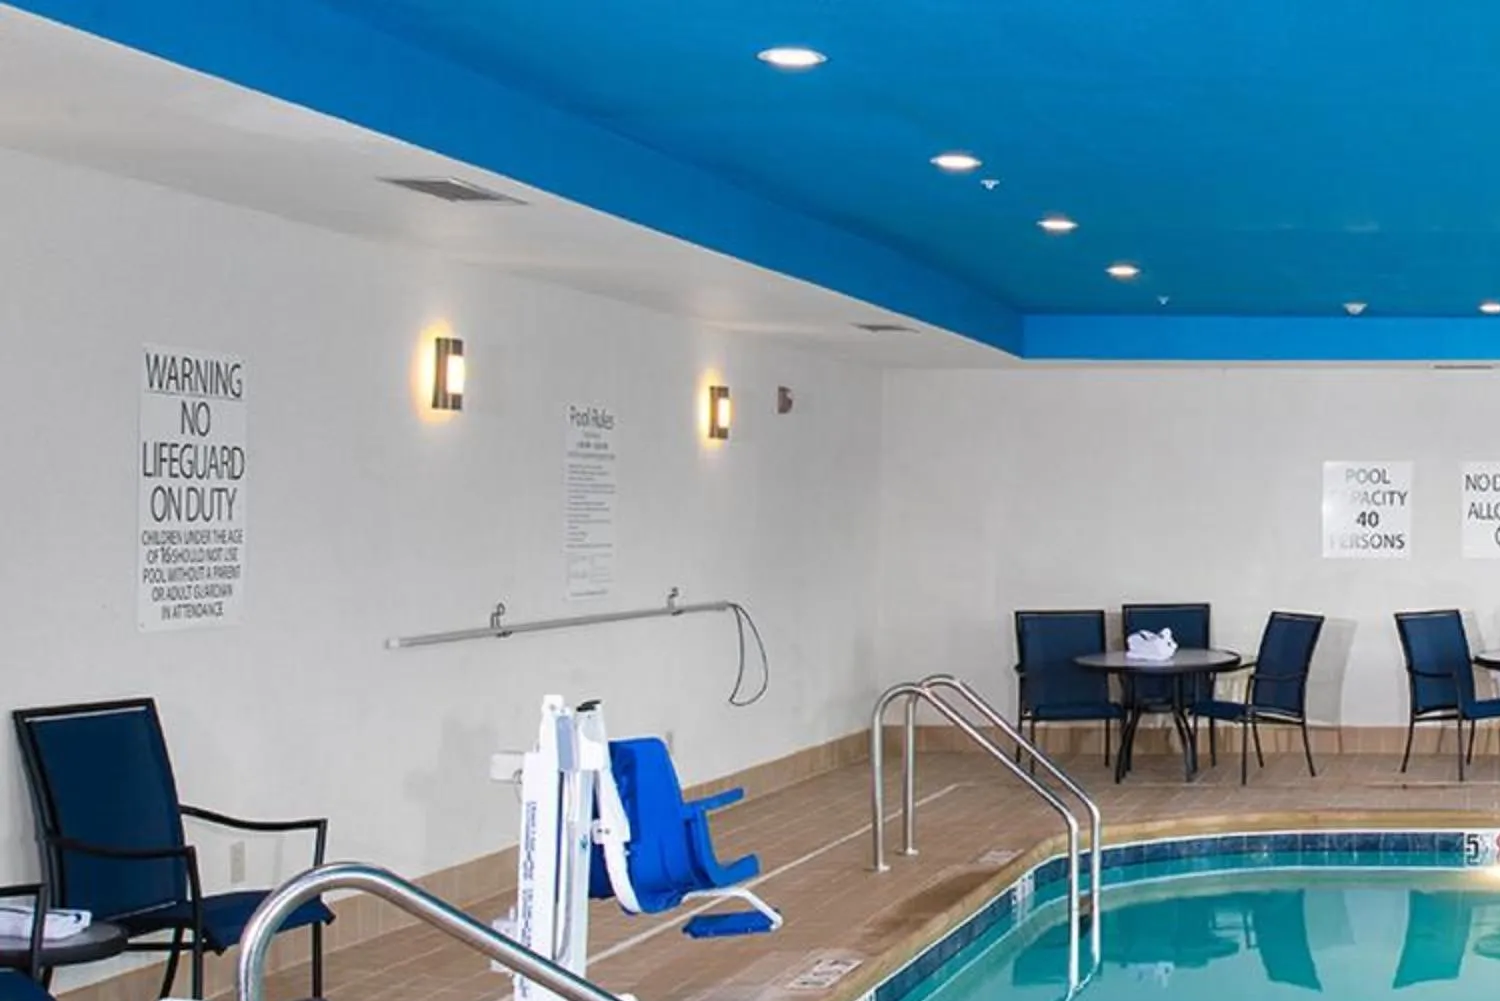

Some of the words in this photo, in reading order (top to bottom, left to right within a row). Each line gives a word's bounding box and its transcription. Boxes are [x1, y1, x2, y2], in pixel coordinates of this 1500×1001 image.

[146, 353, 243, 399] WARNING
[181, 401, 211, 436] NO
[143, 442, 245, 479] LIFEGUARD
[1345, 468, 1391, 485] POOL
[1465, 473, 1490, 492] NO
[151, 486, 182, 522] ON
[185, 486, 237, 522] DUTY
[1356, 511, 1379, 528] 40
